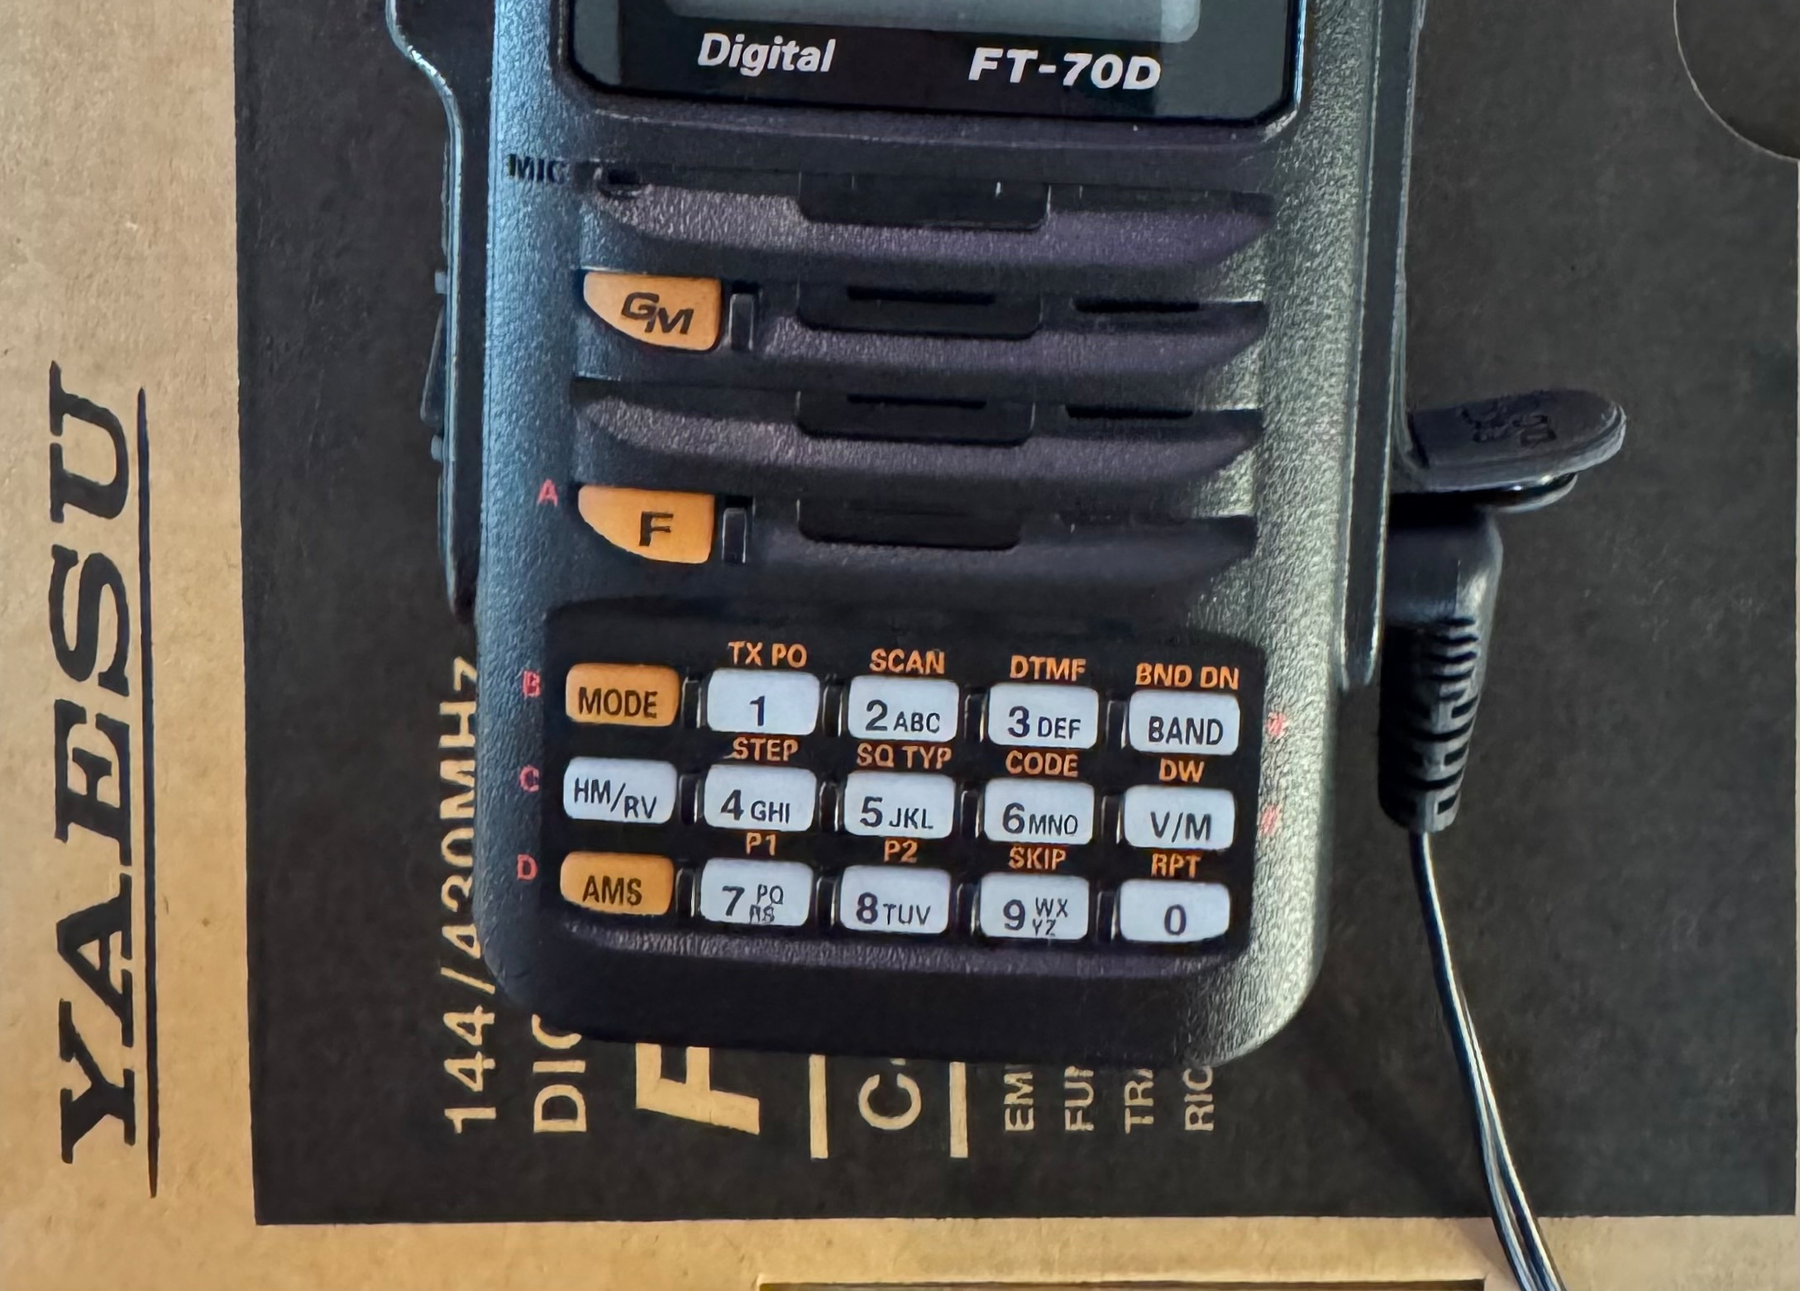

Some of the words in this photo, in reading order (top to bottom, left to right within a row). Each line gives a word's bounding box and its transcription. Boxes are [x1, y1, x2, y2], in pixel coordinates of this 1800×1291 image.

[698, 33, 836, 77] Digital
[968, 47, 1161, 90] FT-70D
[507, 153, 567, 185] MIC
[621, 292, 694, 335] GM
[537, 479, 559, 506] A
[639, 511, 674, 547] F
[728, 641, 764, 666] TX
[768, 643, 808, 668] PO
[870, 648, 945, 676] SCAN
[1009, 656, 1086, 680] DTMF
[522, 671, 541, 696] B
[1135, 663, 1191, 688] BND
[1199, 666, 1239, 689] DN
[578, 688, 658, 719] MODE
[749, 697, 766, 727] 1
[1148, 714, 1224, 746] BAND
[49, 360, 134, 1164] YAESU
[731, 738, 799, 762] STEP
[856, 744, 896, 768] SQ
[901, 746, 951, 769] TYP
[1005, 750, 1079, 777] CODE
[519, 766, 540, 792] C
[1159, 759, 1204, 782] DW
[573, 778, 656, 819] HM/RV
[1150, 810, 1212, 842] V/M
[746, 831, 776, 856] P1
[884, 839, 917, 863] P2
[516, 855, 538, 880] D
[1008, 846, 1066, 870] SKIP
[1151, 853, 1200, 878] RPT
[581, 874, 644, 906] AMS
